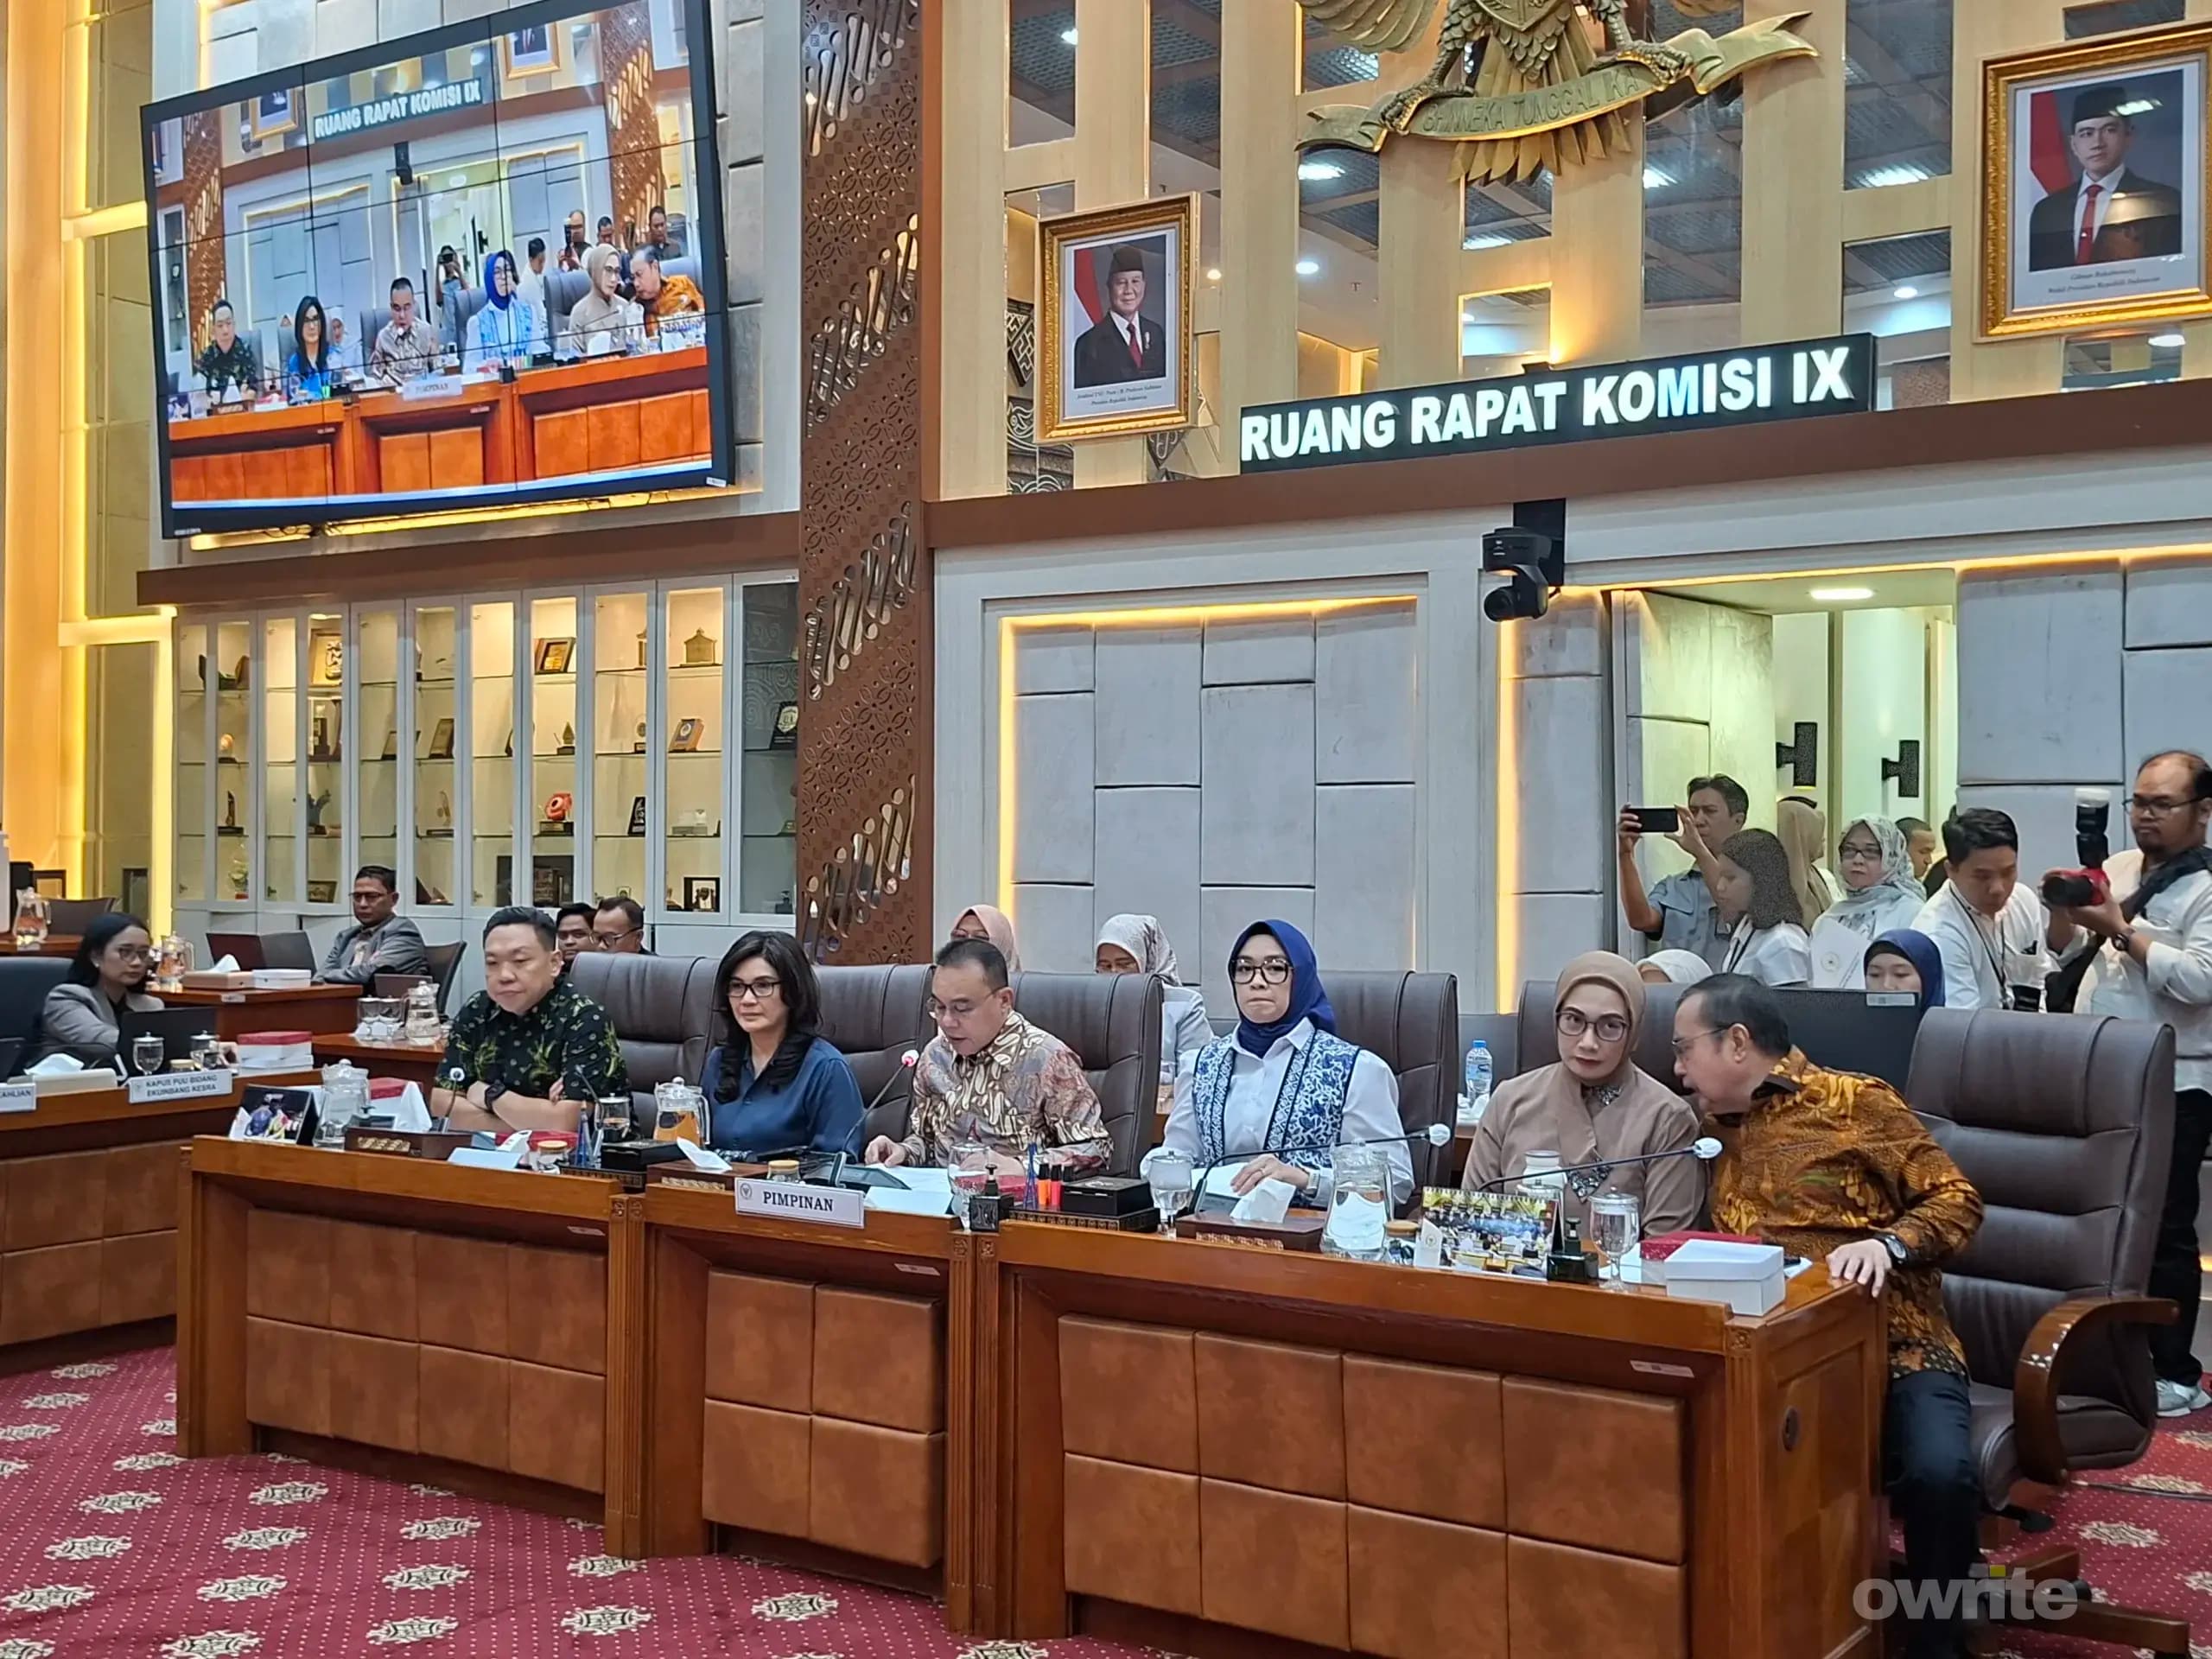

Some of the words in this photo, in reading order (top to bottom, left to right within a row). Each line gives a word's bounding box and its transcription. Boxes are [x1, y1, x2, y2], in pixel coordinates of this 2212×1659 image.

[315, 108, 361, 138] RUANG
[364, 96, 409, 126] RAPAT
[410, 85, 461, 115] KOMISI
[464, 80, 481, 103] IX
[1514, 83, 1600, 127] TUNGGAL
[1605, 65, 1640, 102] IKA
[1241, 402, 1395, 461] RUANG
[1411, 381, 1566, 443] RAPAT
[1582, 356, 1771, 426] KOMISI
[1792, 346, 1853, 404] IX
[763, 1191, 833, 1211] PIMPINAN
